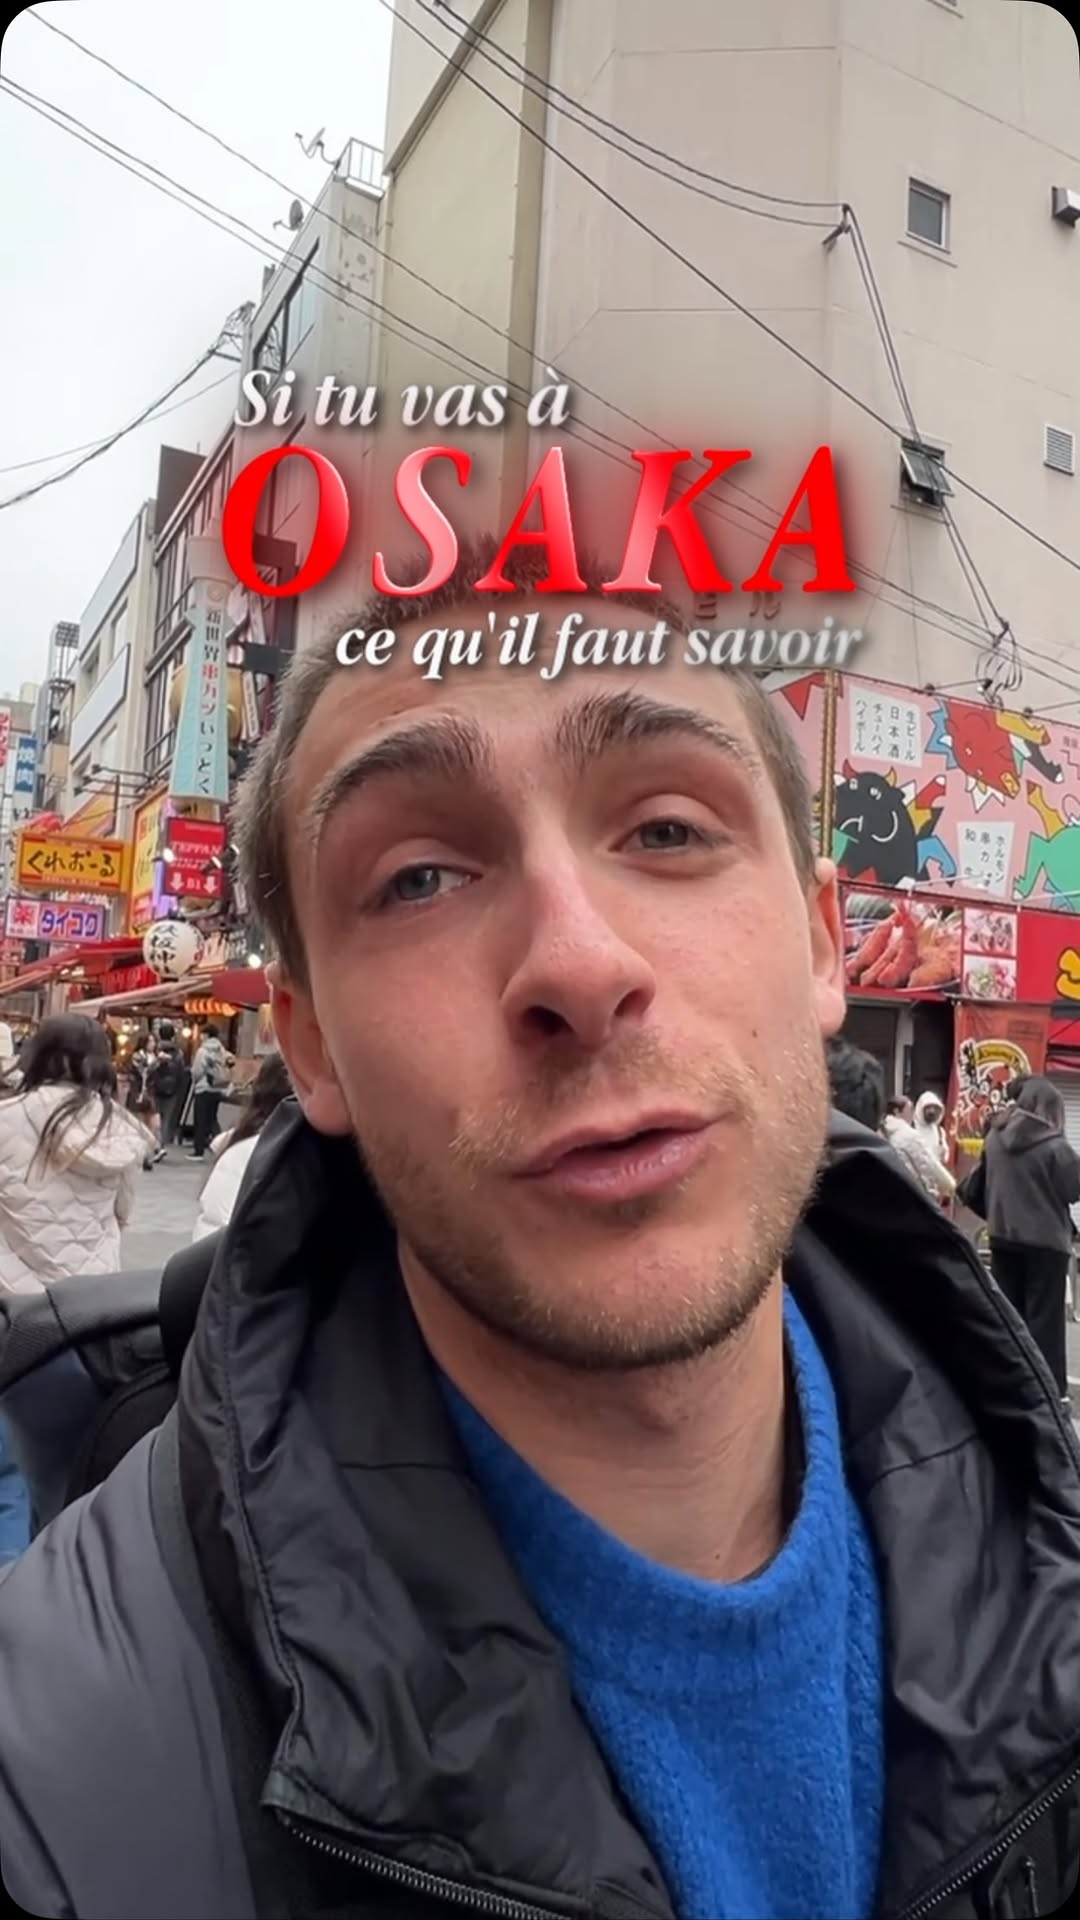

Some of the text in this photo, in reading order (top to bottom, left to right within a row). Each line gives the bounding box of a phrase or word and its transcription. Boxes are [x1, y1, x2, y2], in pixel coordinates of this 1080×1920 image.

[27, 849, 116, 878] くれおーる
